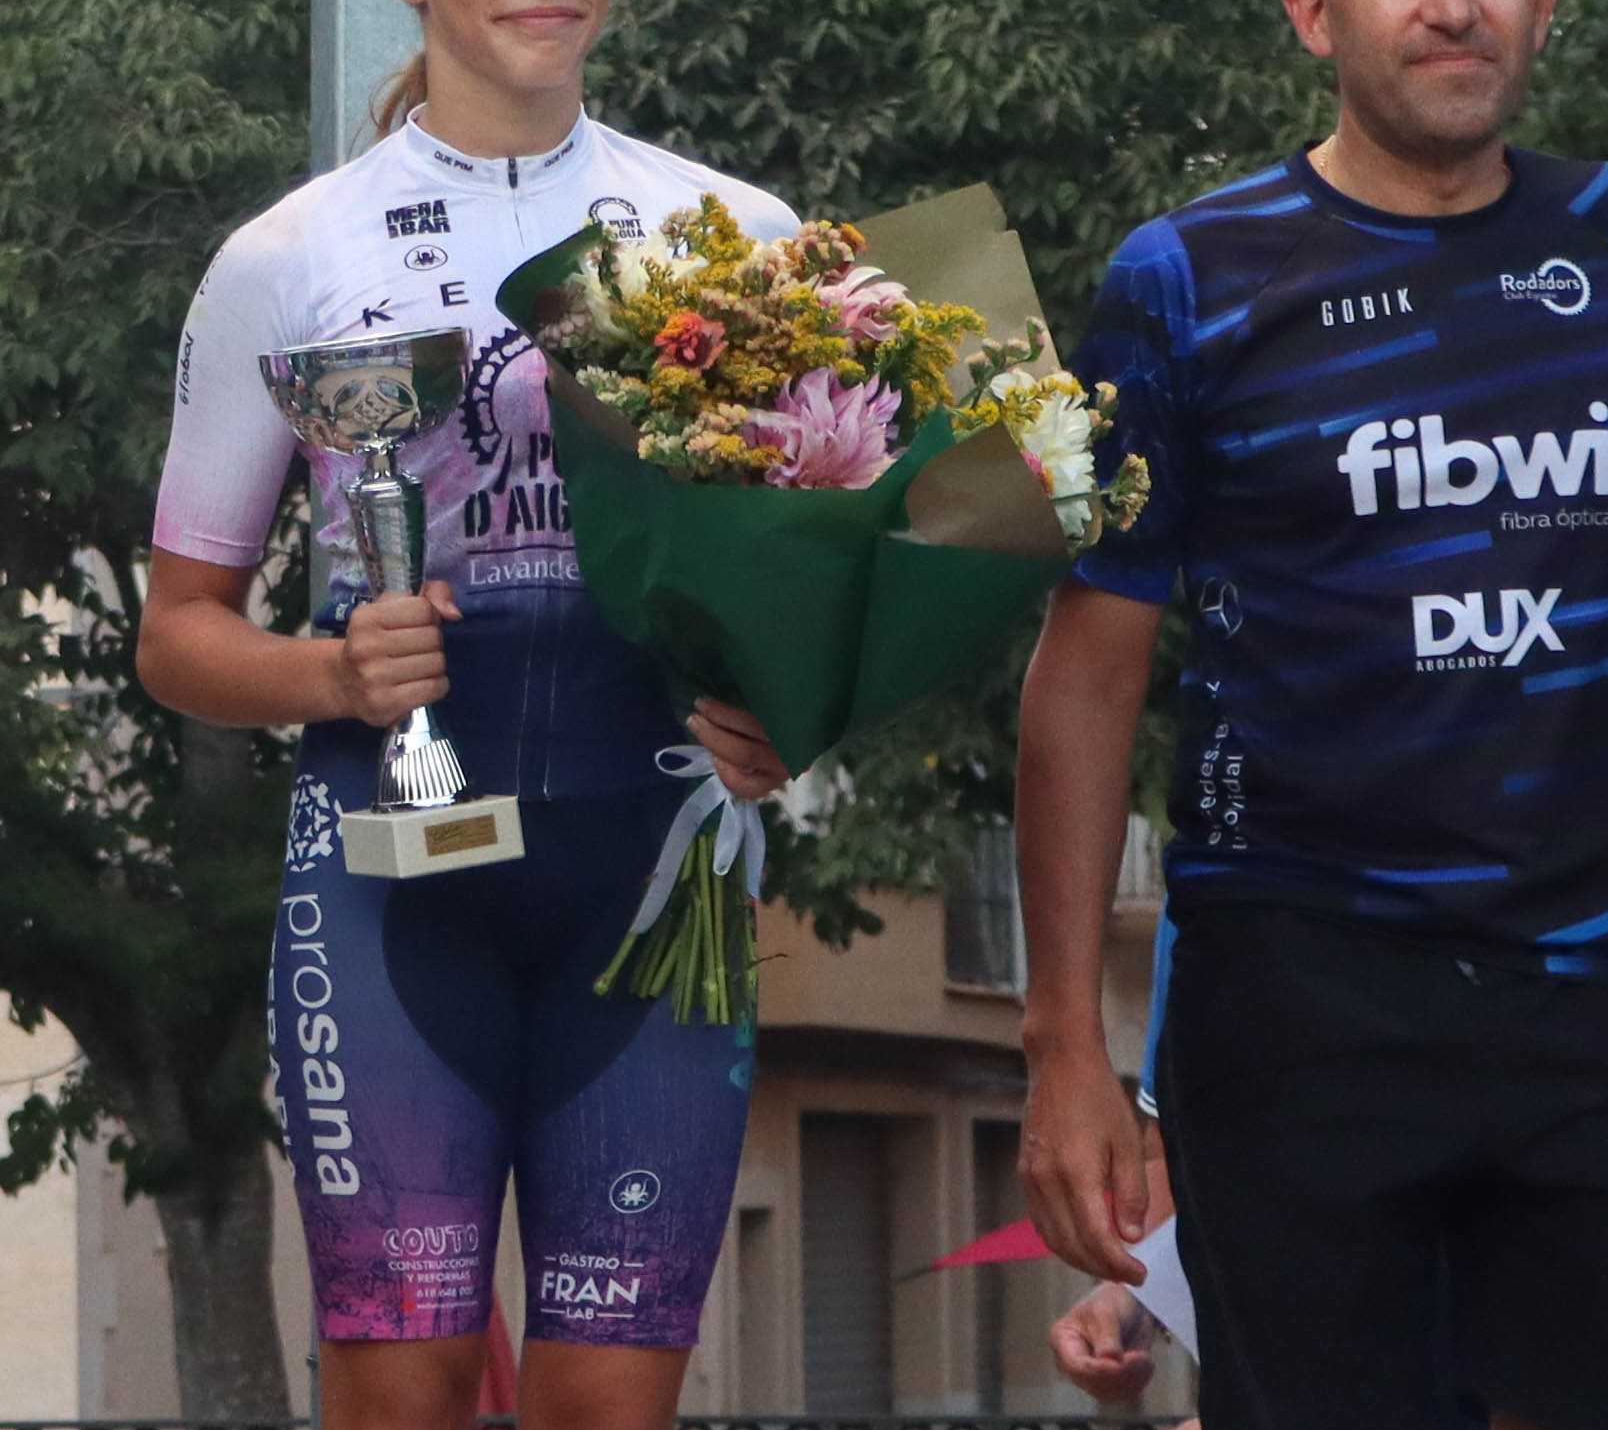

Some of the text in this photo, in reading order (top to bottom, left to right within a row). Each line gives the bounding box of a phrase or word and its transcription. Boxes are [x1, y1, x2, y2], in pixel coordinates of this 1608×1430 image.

[1500, 274, 1581, 293] Rodadors
[1321, 287, 1414, 327] GOBIK
[1500, 511, 1552, 532] fibra
[470, 553, 581, 585] Lavande
[1412, 588, 1566, 667] DUX
[1416, 655, 1497, 673] ABOGADOS
[282, 893, 361, 1197] prosana
[384, 1223, 479, 1257] COUTO
[559, 1253, 620, 1271] GASTRO
[541, 1271, 641, 1307] FRAN
[566, 1307, 595, 1321] LAB
